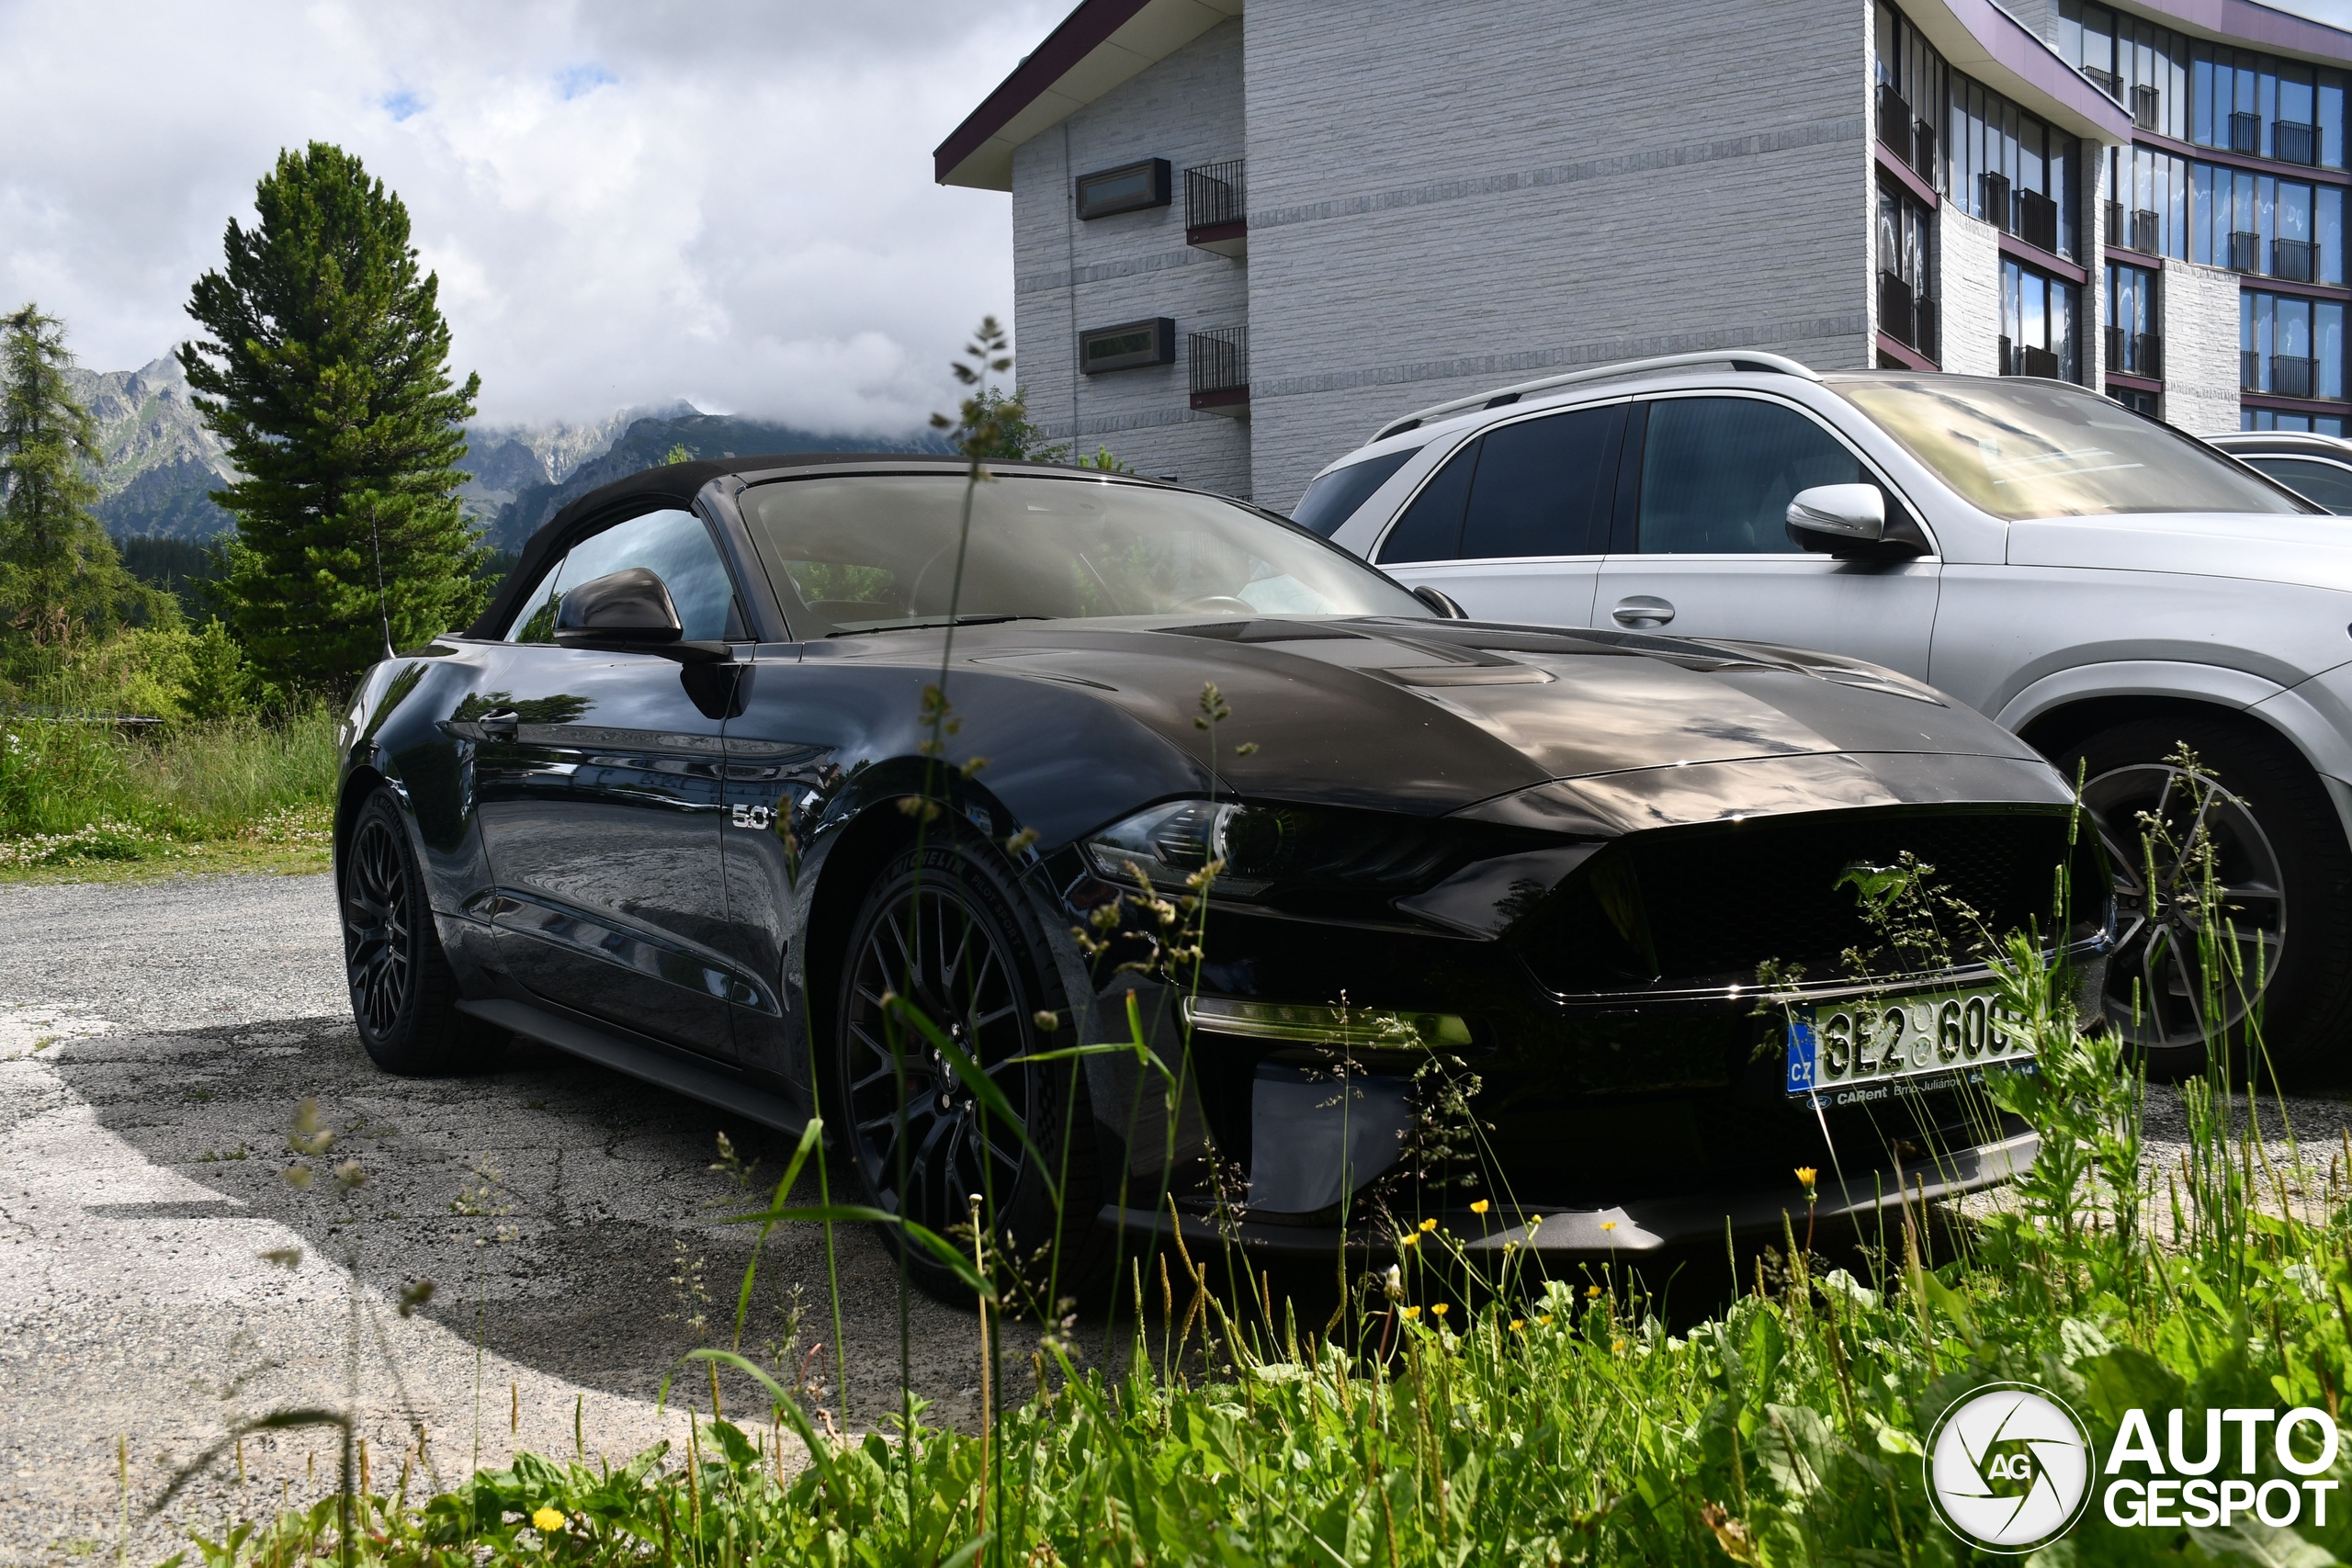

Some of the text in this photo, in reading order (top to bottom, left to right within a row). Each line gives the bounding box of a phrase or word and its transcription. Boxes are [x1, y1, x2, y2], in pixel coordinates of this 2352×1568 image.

[380, 796, 404, 839] MICHELIN
[891, 851, 967, 878] MICHELIN
[970, 874, 998, 902] PILOT
[994, 904, 1022, 946] SPORT
[1826, 1007, 1905, 1076] 6E2
[1792, 1061, 1812, 1081] CZ
[1838, 1087, 1888, 1105] CARent
